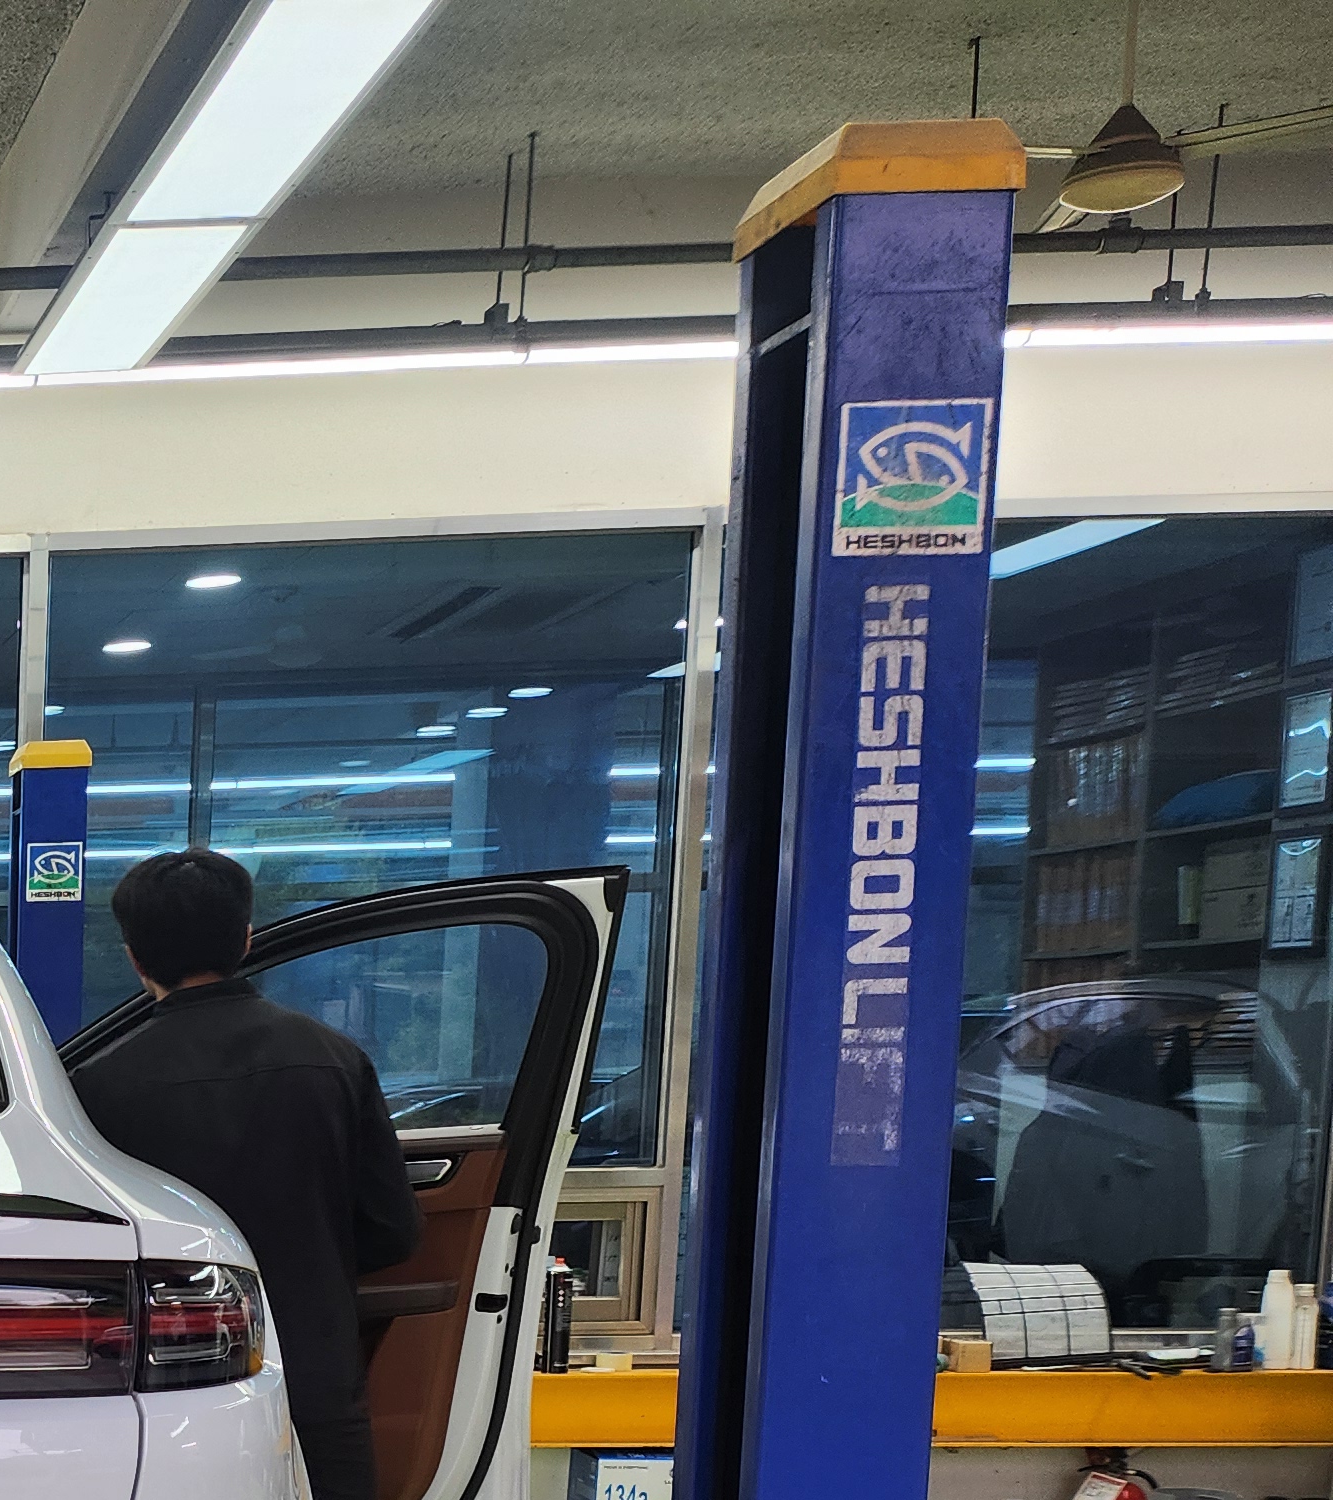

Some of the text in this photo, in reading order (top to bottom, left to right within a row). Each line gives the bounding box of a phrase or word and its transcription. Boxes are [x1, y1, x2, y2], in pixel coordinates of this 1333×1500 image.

[845, 532, 967, 550] HESHBON
[846, 583, 930, 965] HESHBON
[30, 891, 77, 899] HESHBON
